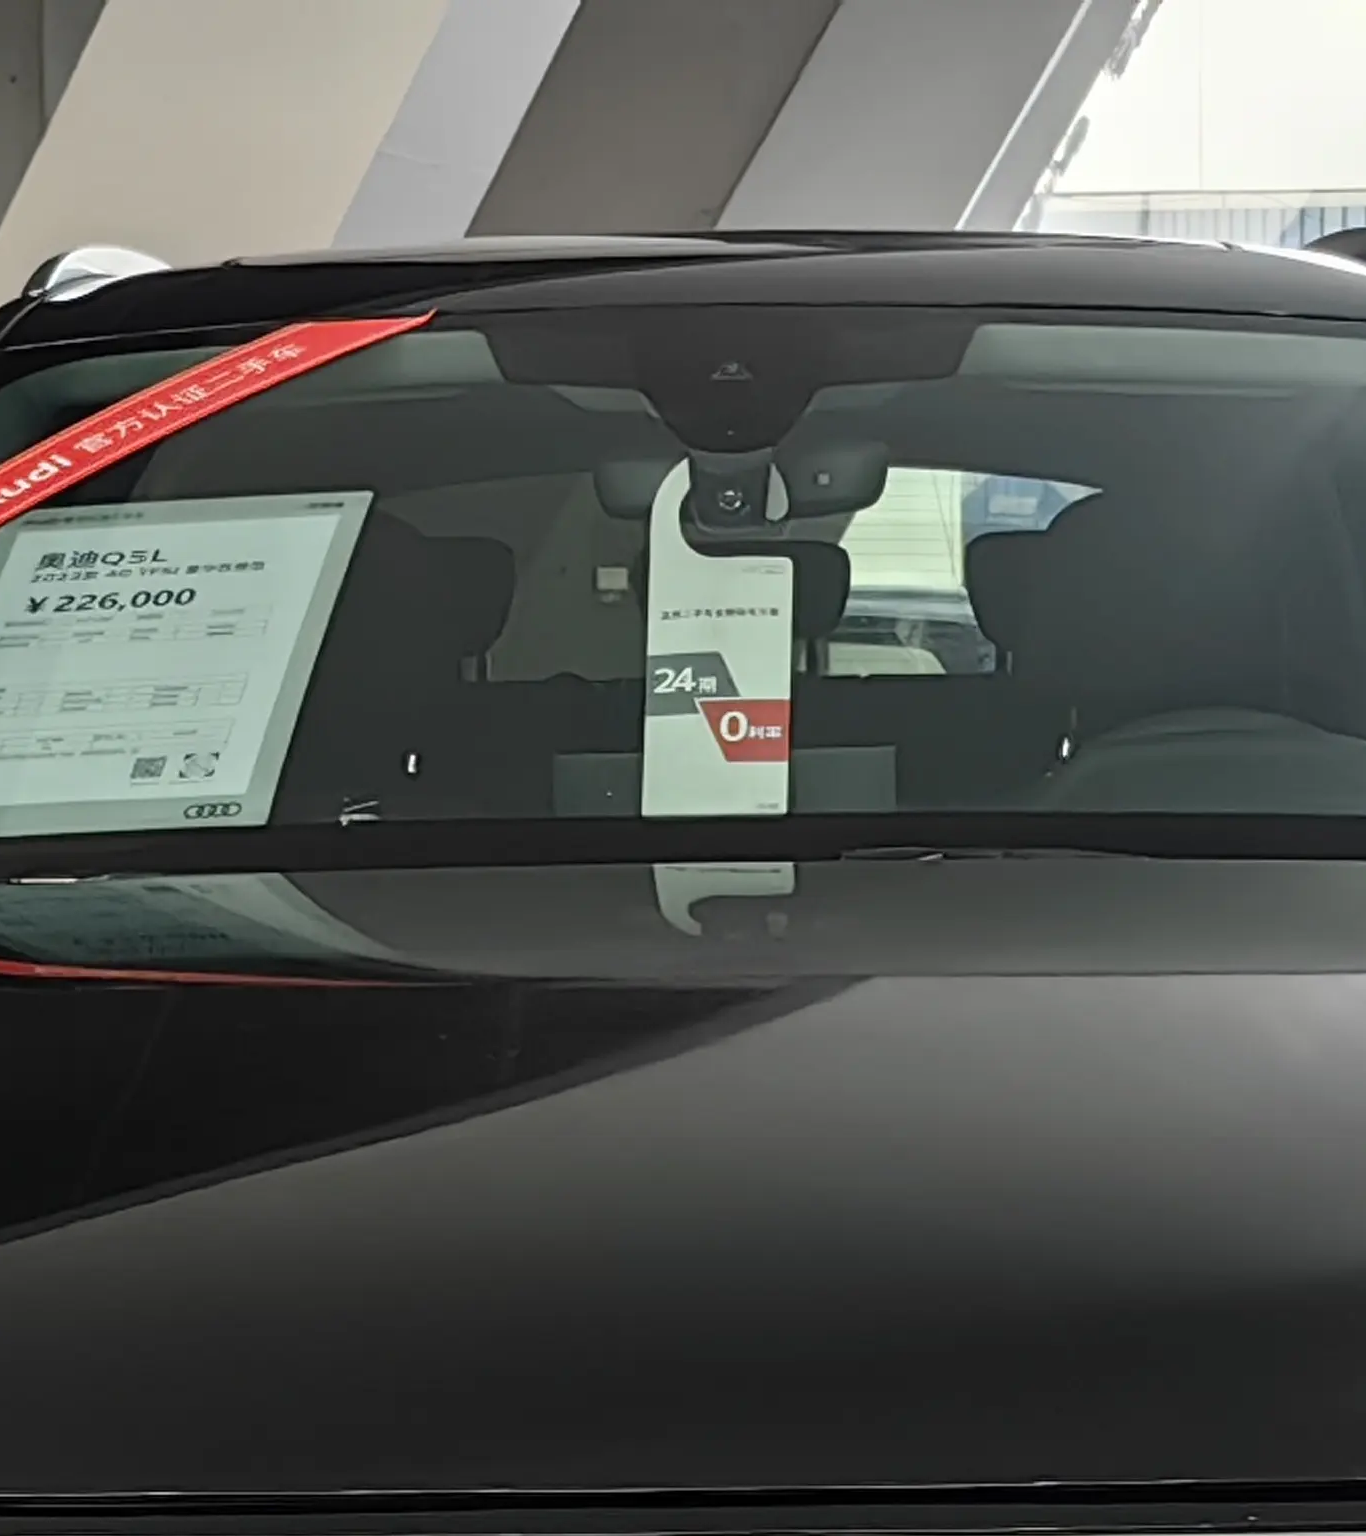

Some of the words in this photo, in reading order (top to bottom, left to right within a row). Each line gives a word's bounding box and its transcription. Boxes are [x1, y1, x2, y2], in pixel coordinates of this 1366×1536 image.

[73, 343, 308, 454] 官方认证二手车
[35, 548, 168, 571] 奥迪Q5L
